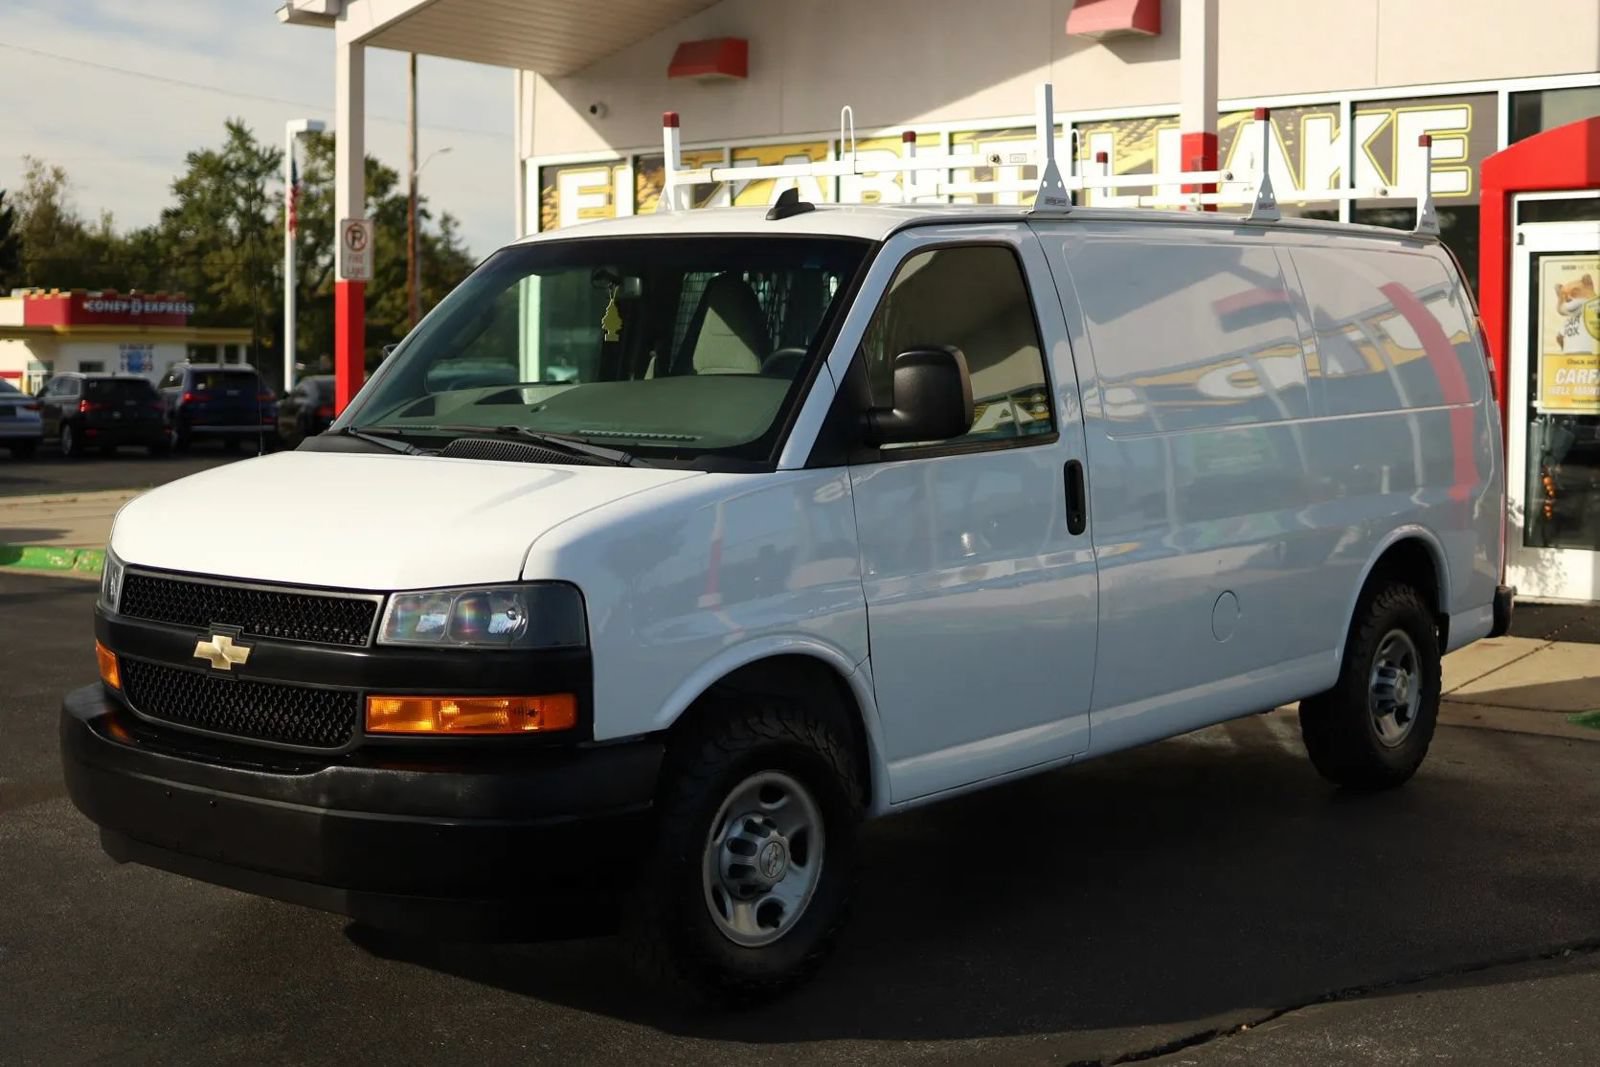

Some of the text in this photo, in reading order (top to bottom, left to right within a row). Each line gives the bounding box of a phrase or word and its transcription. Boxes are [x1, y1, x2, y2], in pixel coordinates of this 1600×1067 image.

[88, 300, 129, 312] CONEY
[144, 302, 195, 314] EXPRESS
[1555, 368, 1600, 384] CARF
